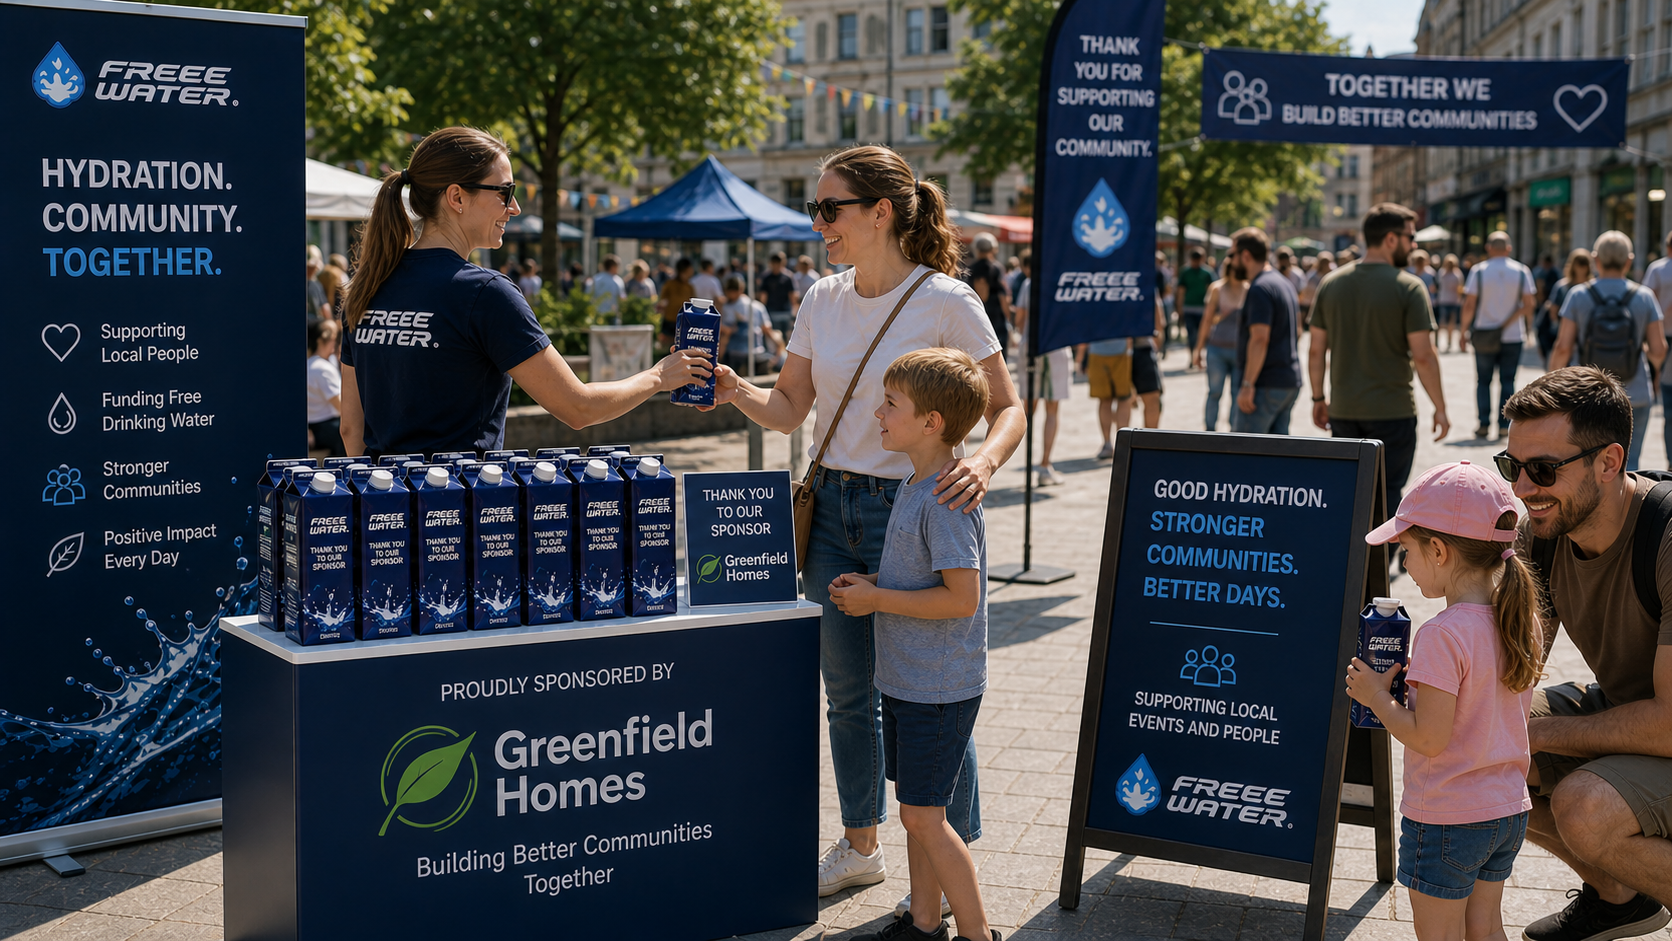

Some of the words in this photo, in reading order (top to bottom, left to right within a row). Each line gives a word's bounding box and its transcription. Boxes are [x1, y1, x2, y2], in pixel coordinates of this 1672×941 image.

[1080, 35, 1140, 56] THANK
[98, 60, 232, 84] FREEE
[1074, 61, 1108, 80] YOU
[1112, 63, 1142, 81] FOR
[1326, 72, 1448, 99] TOGETHER
[1453, 78, 1491, 100] WE
[1057, 87, 1155, 107] SUPPORTING
[1088, 114, 1124, 132] OUR
[1282, 103, 1335, 125] BUILD
[1338, 106, 1404, 128] BETTER
[1407, 108, 1538, 130] COMMUNITIES
[1056, 138, 1152, 157] COMMUNITY.
[42, 158, 232, 190] HYDRATION.
[42, 203, 242, 233] COMMUNITY.
[43, 247, 222, 277] TOGETHER.
[1058, 272, 1141, 286] FREEE
[358, 310, 434, 328] FREEE
[101, 322, 186, 342] Supporting
[102, 347, 142, 362] Local
[148, 344, 199, 363] People
[102, 391, 164, 408] Funding
[169, 390, 201, 404] Free
[102, 414, 166, 432] Drinking
[170, 412, 214, 428] Water
[103, 460, 169, 477] Stronger
[103, 480, 201, 500] Communities
[703, 488, 746, 501] THANK
[749, 487, 774, 500] YOU
[1154, 479, 1209, 500] GOOD
[1214, 483, 1328, 508] HYDRATION.
[481, 507, 514, 515] FREEE
[534, 504, 567, 512] FREEE
[587, 501, 619, 509] FREEE
[639, 498, 670, 506] FREEE
[310, 516, 347, 526] FREEE
[370, 513, 404, 522] FREEE
[426, 510, 460, 518] FREEE
[716, 506, 733, 518] TO
[736, 506, 762, 518] OUR
[711, 522, 771, 536] SPONSOR
[1150, 510, 1264, 538] STRONGER
[104, 528, 162, 546] Positive
[167, 524, 216, 543] Impact
[480, 534, 501, 542] THANK
[310, 546, 333, 554] THANK
[369, 541, 390, 549] THANK
[376, 550, 384, 558] TO
[432, 546, 440, 554] TO
[482, 549, 514, 558] SPONSOR
[536, 546, 566, 554] SPONSOR
[588, 542, 618, 551] SPONSOR
[105, 553, 146, 570] Every
[151, 550, 180, 566] Day
[312, 562, 346, 571] SPONSOR
[371, 558, 404, 566] SPONSOR
[428, 553, 460, 562] SPONSOR
[725, 552, 788, 566] Greenfield
[1147, 544, 1298, 575] COMMUNITIES.
[726, 569, 770, 582] Homes
[1144, 577, 1220, 603] BETTER
[1226, 584, 1286, 609] DAYS.
[441, 676, 529, 702] PROUDLY
[534, 665, 646, 692] SPONSORED
[652, 662, 674, 680] BY
[1134, 691, 1227, 716] SUPPORTING
[1230, 702, 1278, 722] LOCAL
[1128, 713, 1184, 734] EVENTS
[1187, 720, 1220, 738] AND
[1224, 724, 1280, 745] PEOPLE
[494, 708, 713, 770] Greenfield
[496, 770, 646, 817] Homes
[1172, 776, 1292, 806] FREEE
[417, 850, 506, 878] Building
[514, 840, 577, 866] Better
[584, 822, 713, 856] Communities
[524, 866, 614, 896] Together
